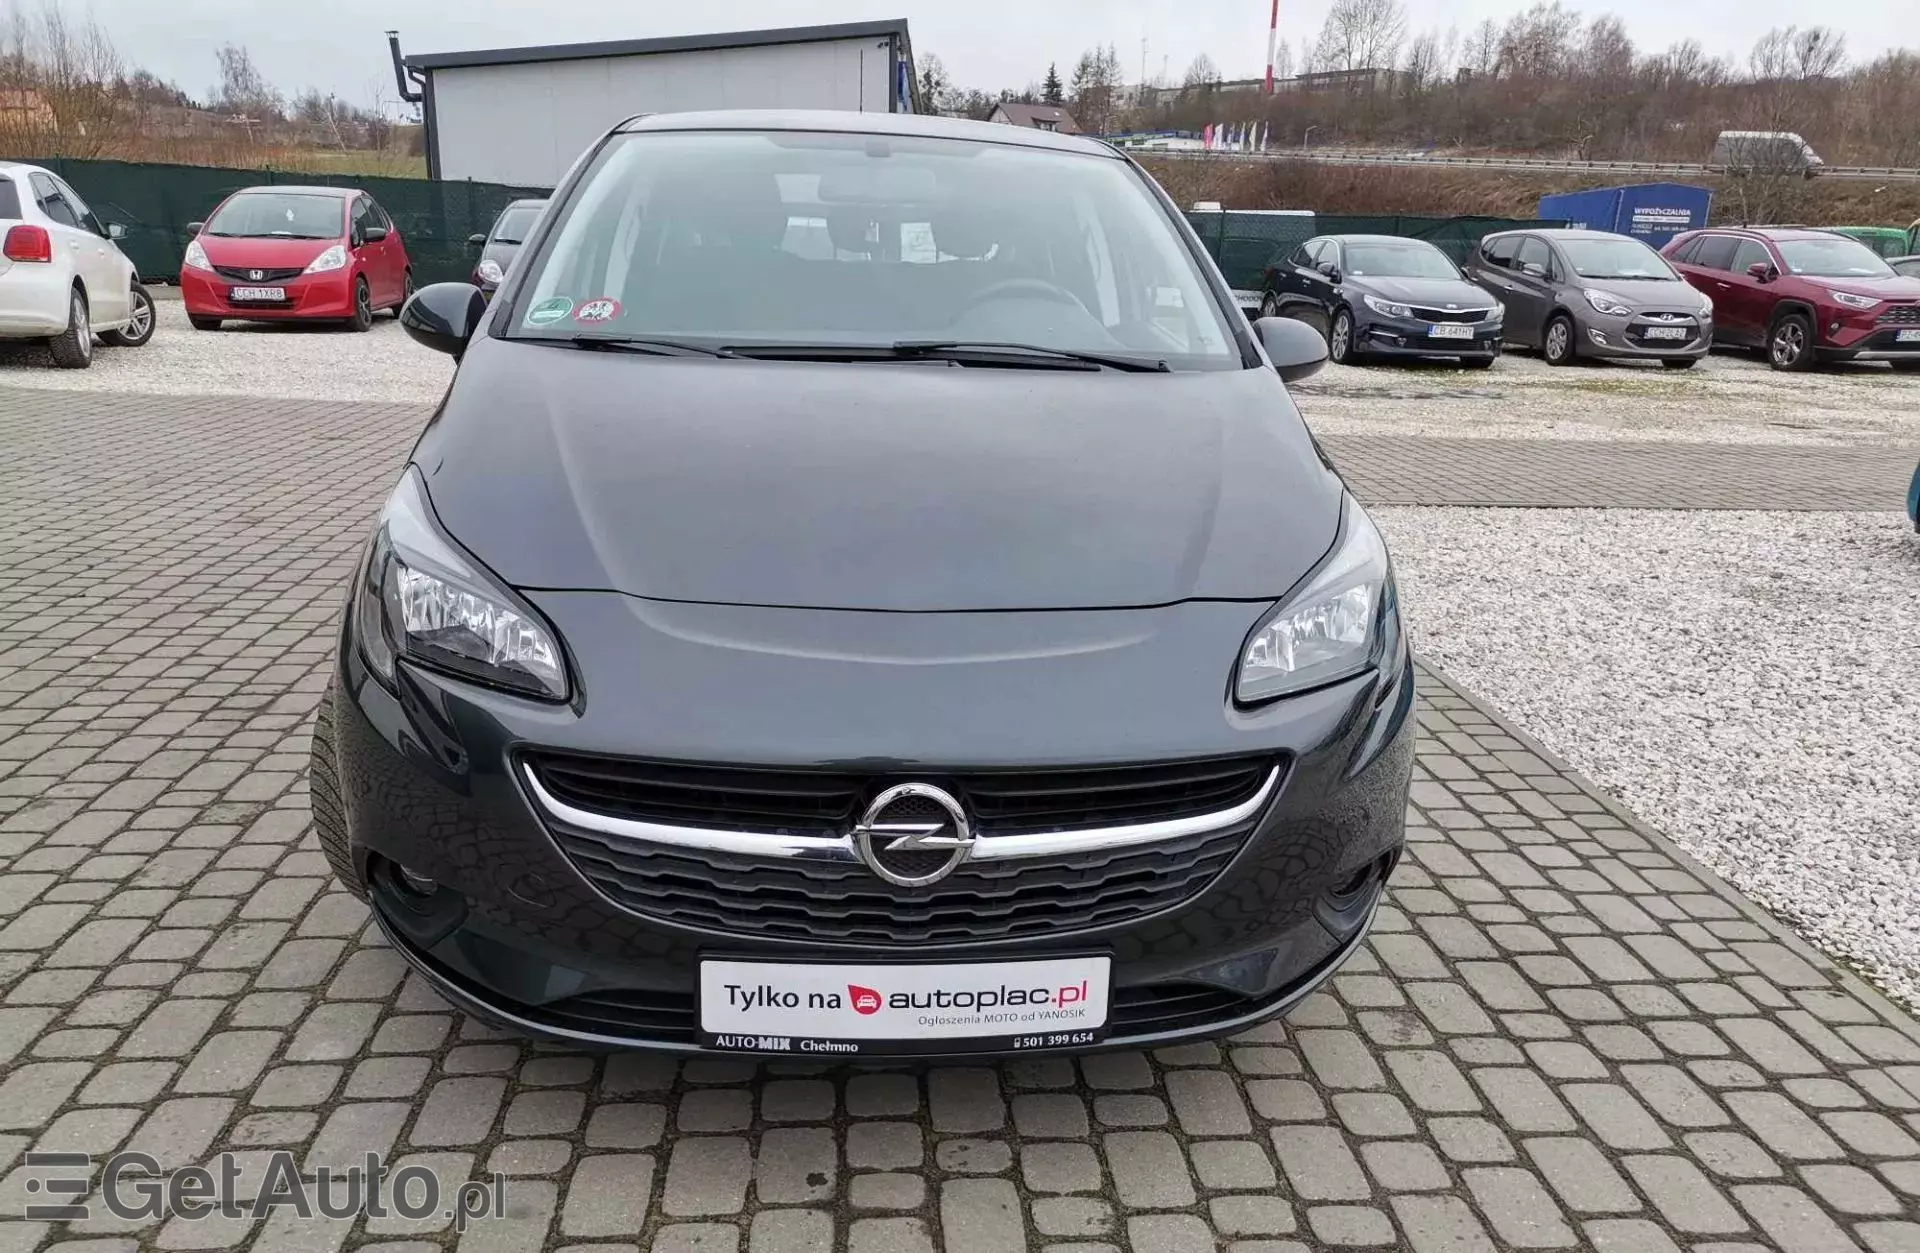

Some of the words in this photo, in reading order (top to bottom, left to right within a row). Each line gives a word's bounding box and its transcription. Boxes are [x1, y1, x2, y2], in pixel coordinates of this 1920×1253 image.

[724, 984, 800, 1012] Tylko
[808, 992, 842, 1009] na
[888, 980, 1087, 1013] autoplac.pl
[918, 1015, 981, 1027] Ogłoszenia
[984, 1012, 1018, 1024] MOTO
[1021, 1011, 1035, 1021] od
[1038, 1008, 1086, 1020] YANOSIK
[715, 1035, 791, 1051] AUTO-MIX
[800, 1039, 859, 1053] Chełmno
[1022, 1036, 1043, 1048] 501
[1047, 1034, 1069, 1046] 399
[1072, 1032, 1094, 1044] 654
